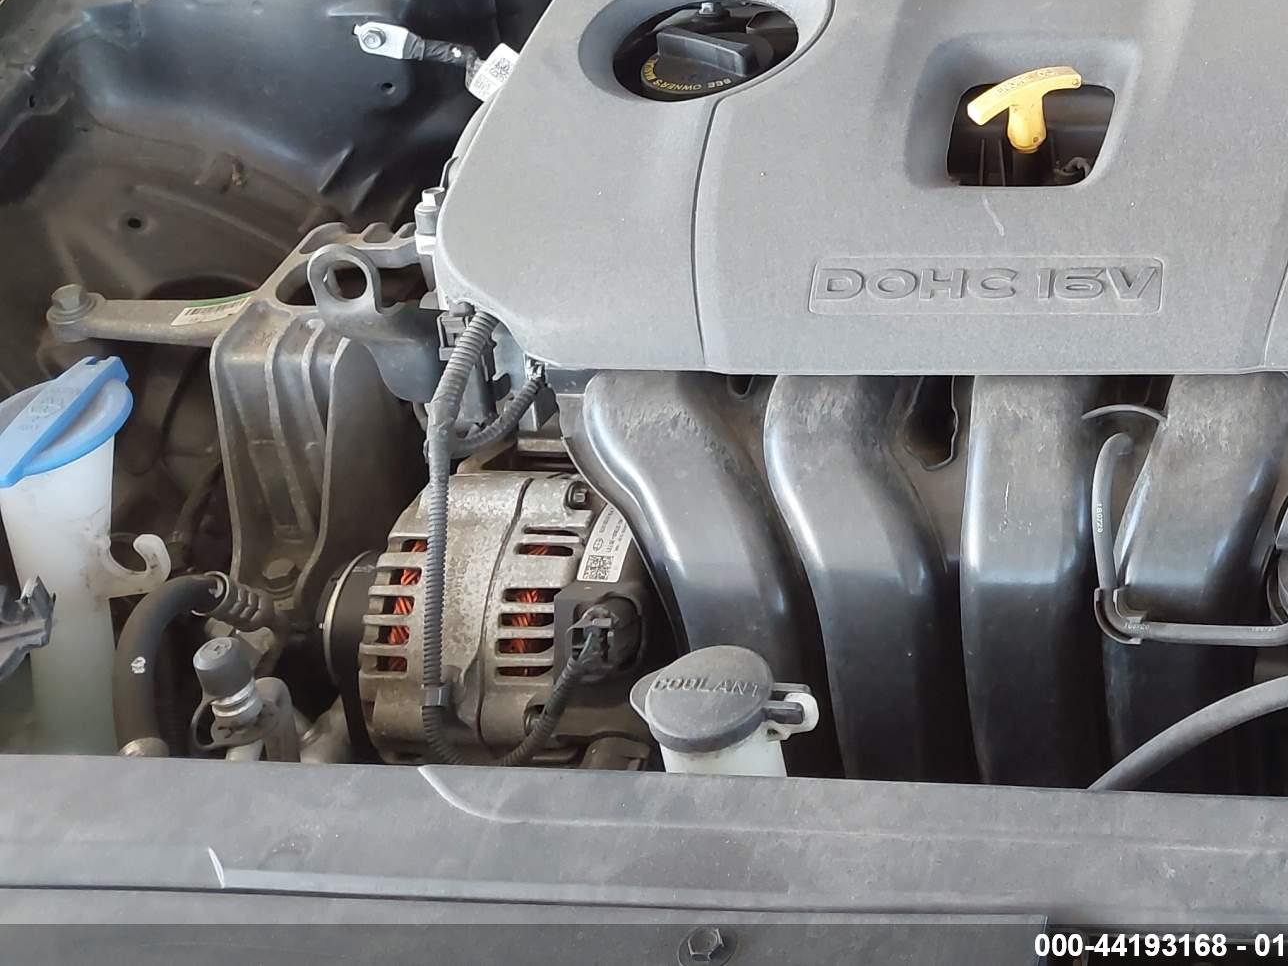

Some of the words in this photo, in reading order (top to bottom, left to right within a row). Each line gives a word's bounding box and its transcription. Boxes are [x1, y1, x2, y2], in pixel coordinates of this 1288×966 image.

[652, 78, 702, 91] OWNERS
[814, 267, 1017, 301] DOHC
[1036, 266, 1157, 301] 16V
[651, 676, 762, 698] COOLANT
